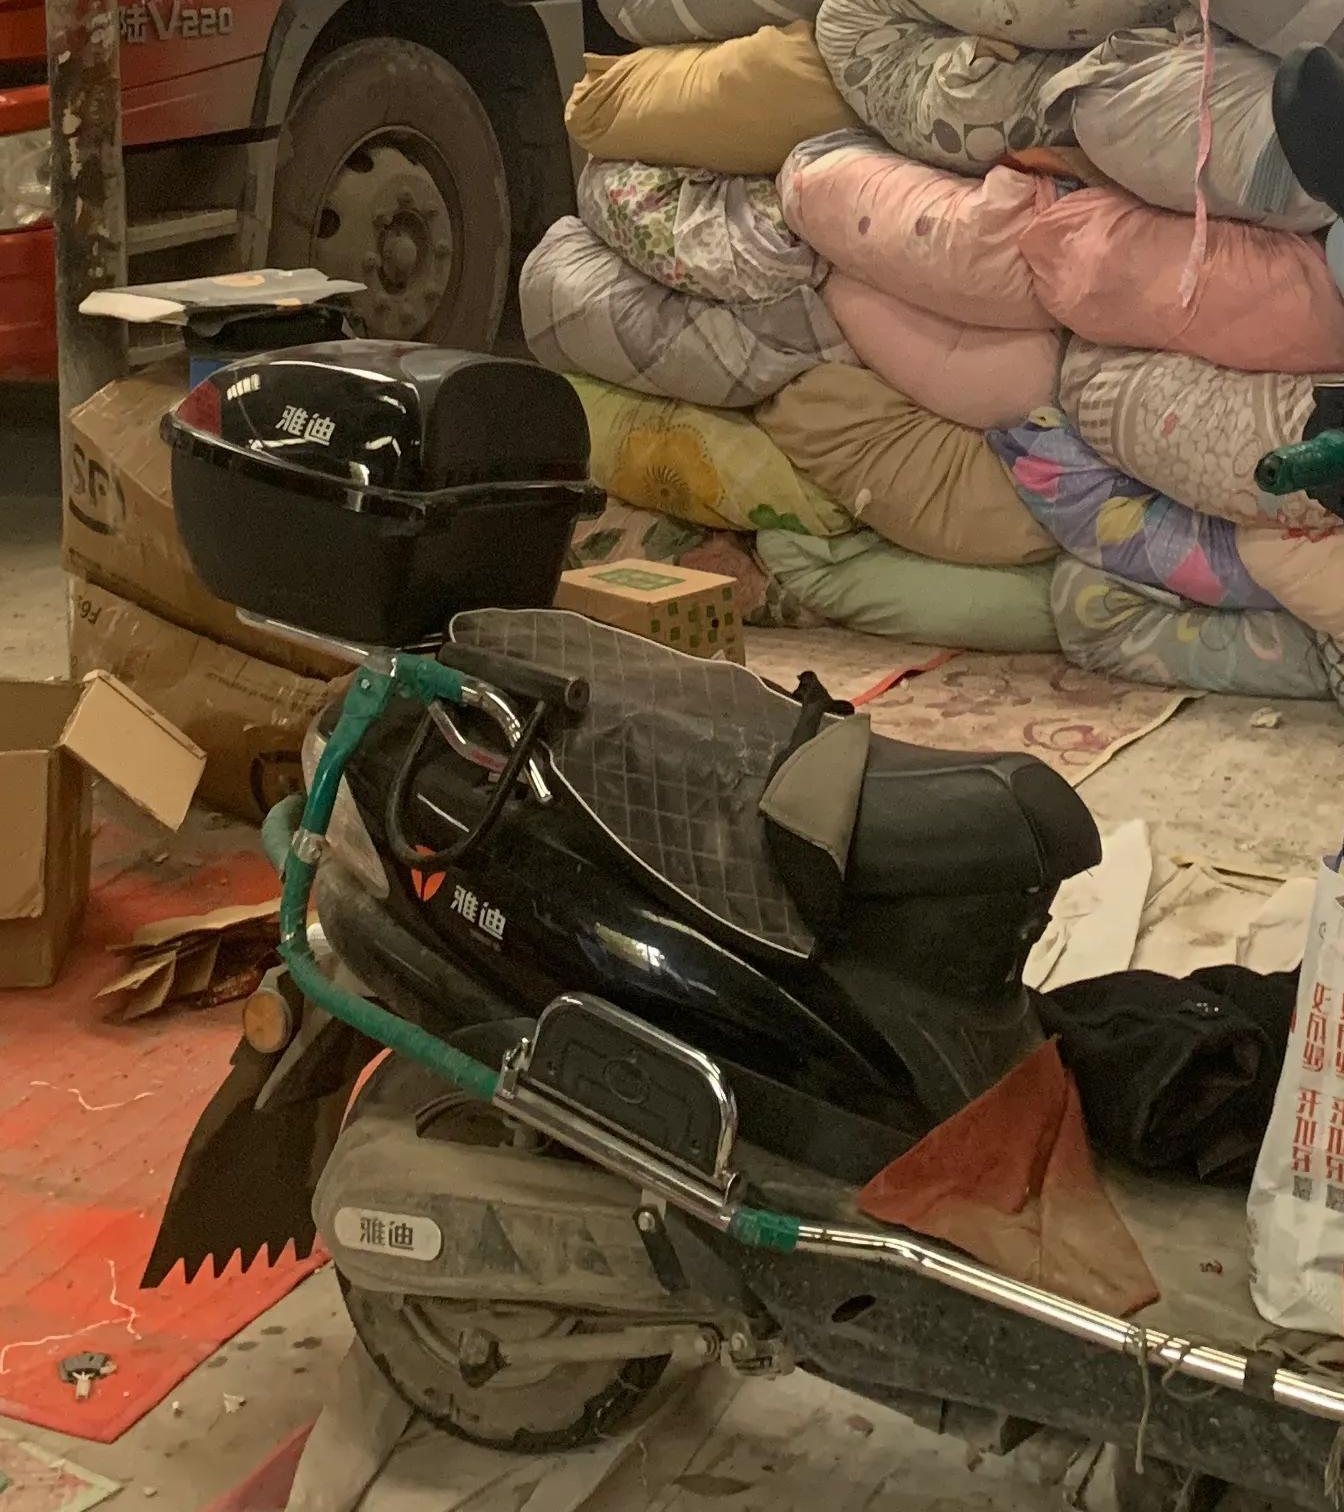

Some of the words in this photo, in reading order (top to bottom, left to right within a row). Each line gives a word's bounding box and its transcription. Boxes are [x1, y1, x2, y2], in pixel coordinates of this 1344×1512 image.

[276, 404, 336, 446] 雅迪
[450, 884, 507, 941] 雅迪
[359, 1216, 414, 1251] 雅迪
